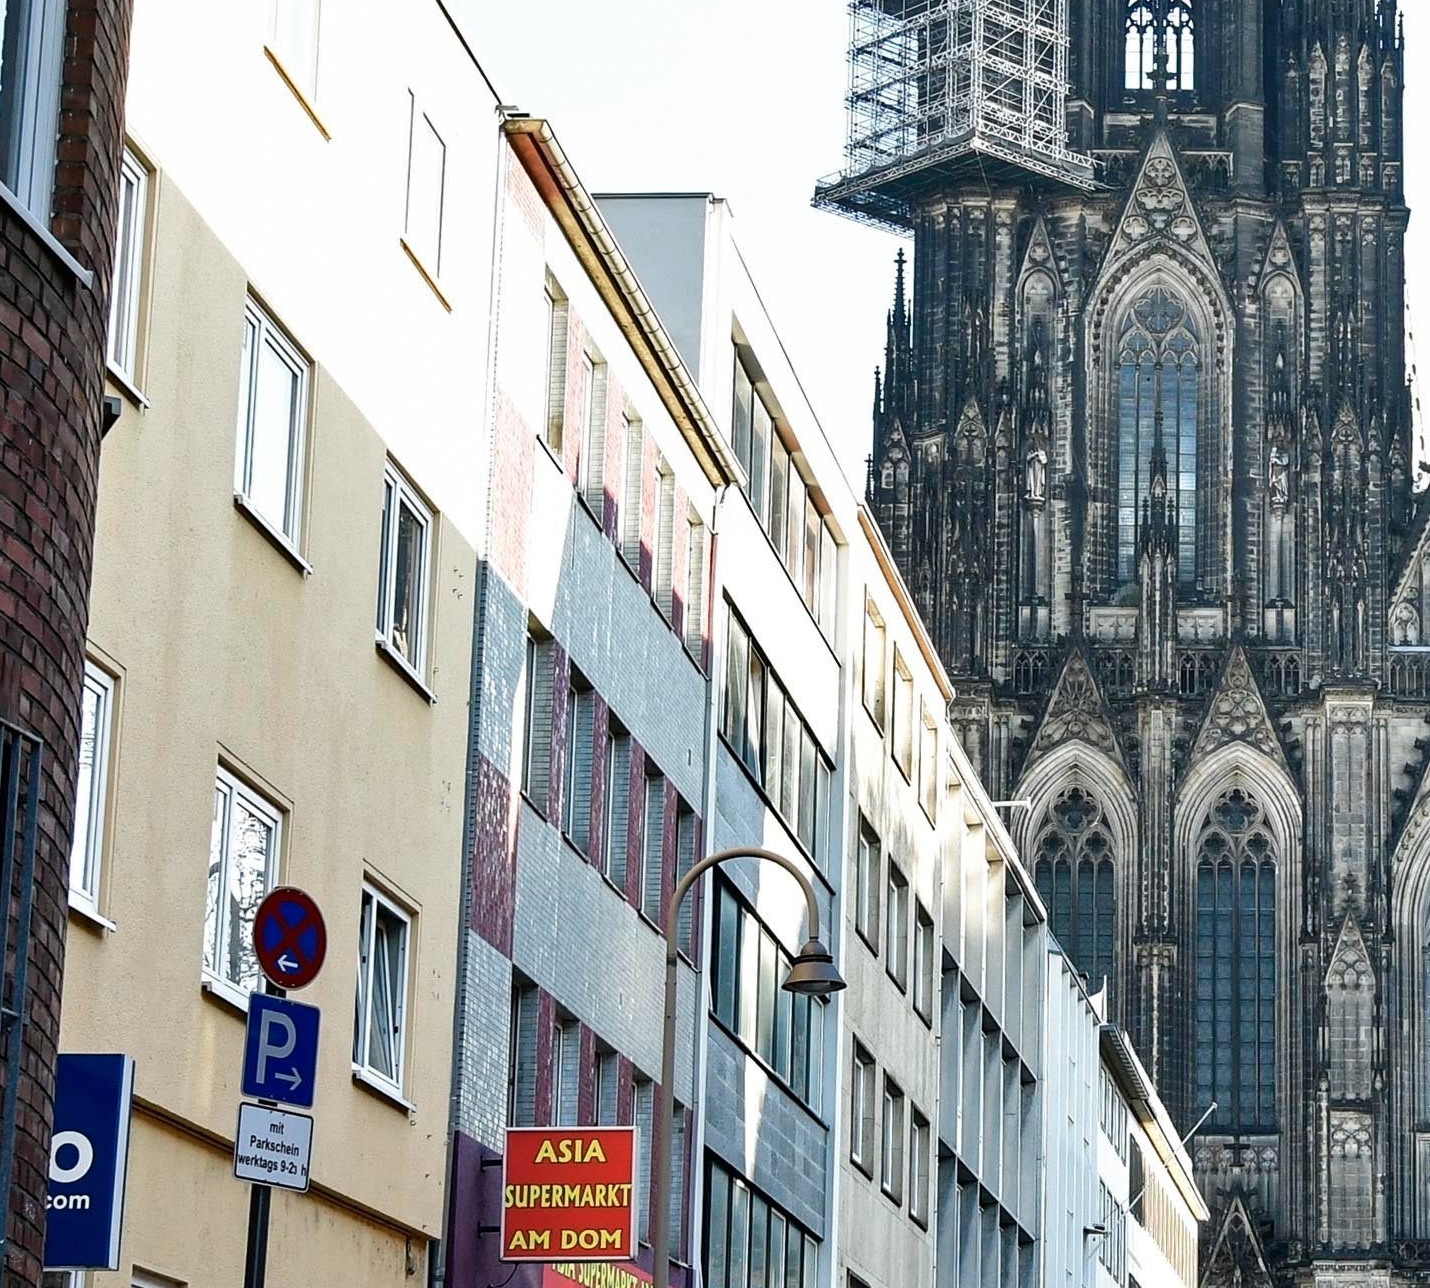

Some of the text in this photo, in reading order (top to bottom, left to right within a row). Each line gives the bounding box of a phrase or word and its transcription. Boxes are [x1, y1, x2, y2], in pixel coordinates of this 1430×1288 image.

[255, 1008, 297, 1085] P
[269, 1121, 285, 1135] mit
[250, 1134, 300, 1157] Parkschein
[534, 1139, 607, 1163] ASIA
[238, 1154, 278, 1173] werktags
[301, 1163, 307, 1177] h
[504, 1184, 633, 1208] SUPERMARKT
[508, 1229, 623, 1250] AM DOM
